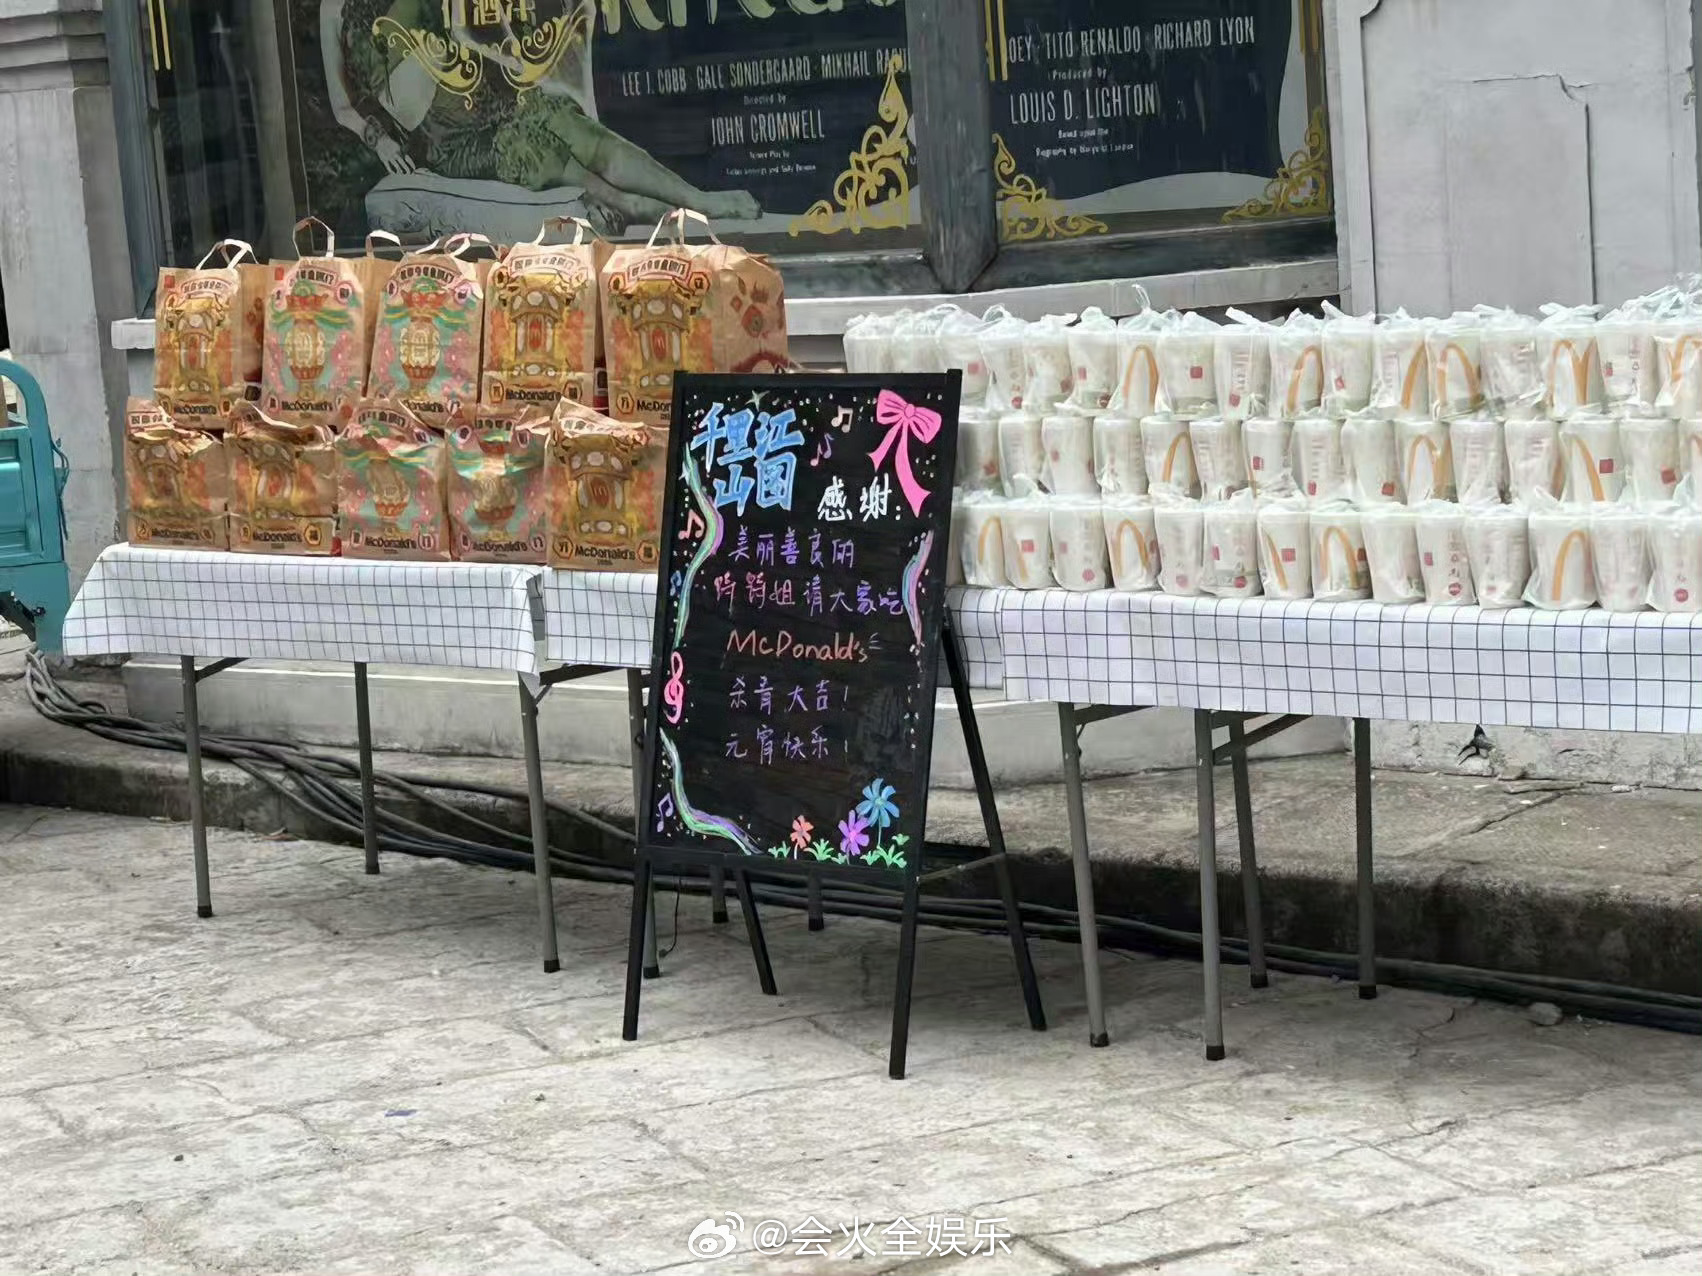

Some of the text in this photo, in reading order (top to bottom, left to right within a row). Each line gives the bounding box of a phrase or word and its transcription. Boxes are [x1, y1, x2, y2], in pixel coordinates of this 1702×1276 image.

[1008, 15, 1255, 63] OEY TITO RENALDO RICHARD LYON
[622, 71, 641, 97] LEE
[658, 66, 687, 94] COBB
[697, 63, 724, 90] GALE
[730, 55, 812, 88] SONDERGAARD
[820, 50, 871, 80] MIKHAIL
[1010, 83, 1156, 124] LOUIS D. LIGHTON
[711, 109, 825, 146] JOHN CROMWELL
[690, 401, 805, 473] 千里江
[712, 451, 798, 517] 山图
[726, 629, 869, 663] McDonald's
